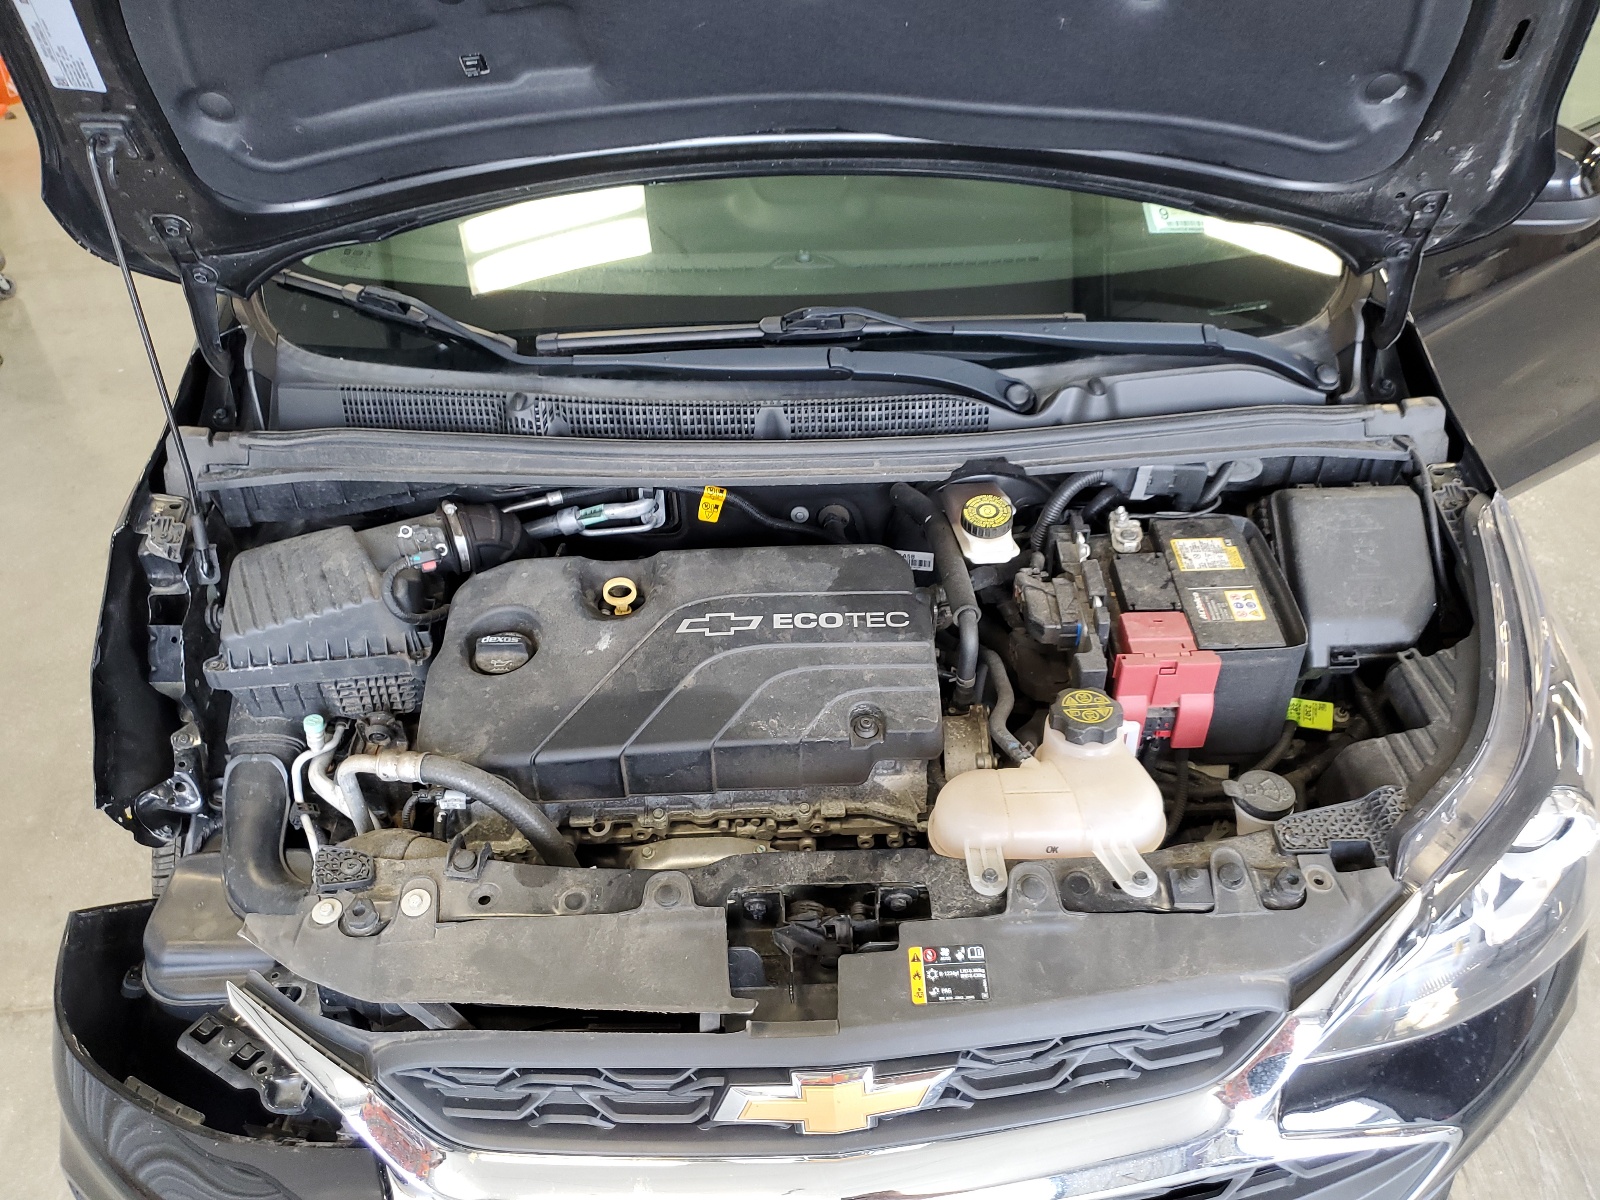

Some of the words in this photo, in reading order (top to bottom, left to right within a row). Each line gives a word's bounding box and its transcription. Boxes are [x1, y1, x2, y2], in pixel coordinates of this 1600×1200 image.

[773, 611, 910, 629] ECOTEC
[481, 635, 522, 643] dexos
[1046, 845, 1059, 854] OK
